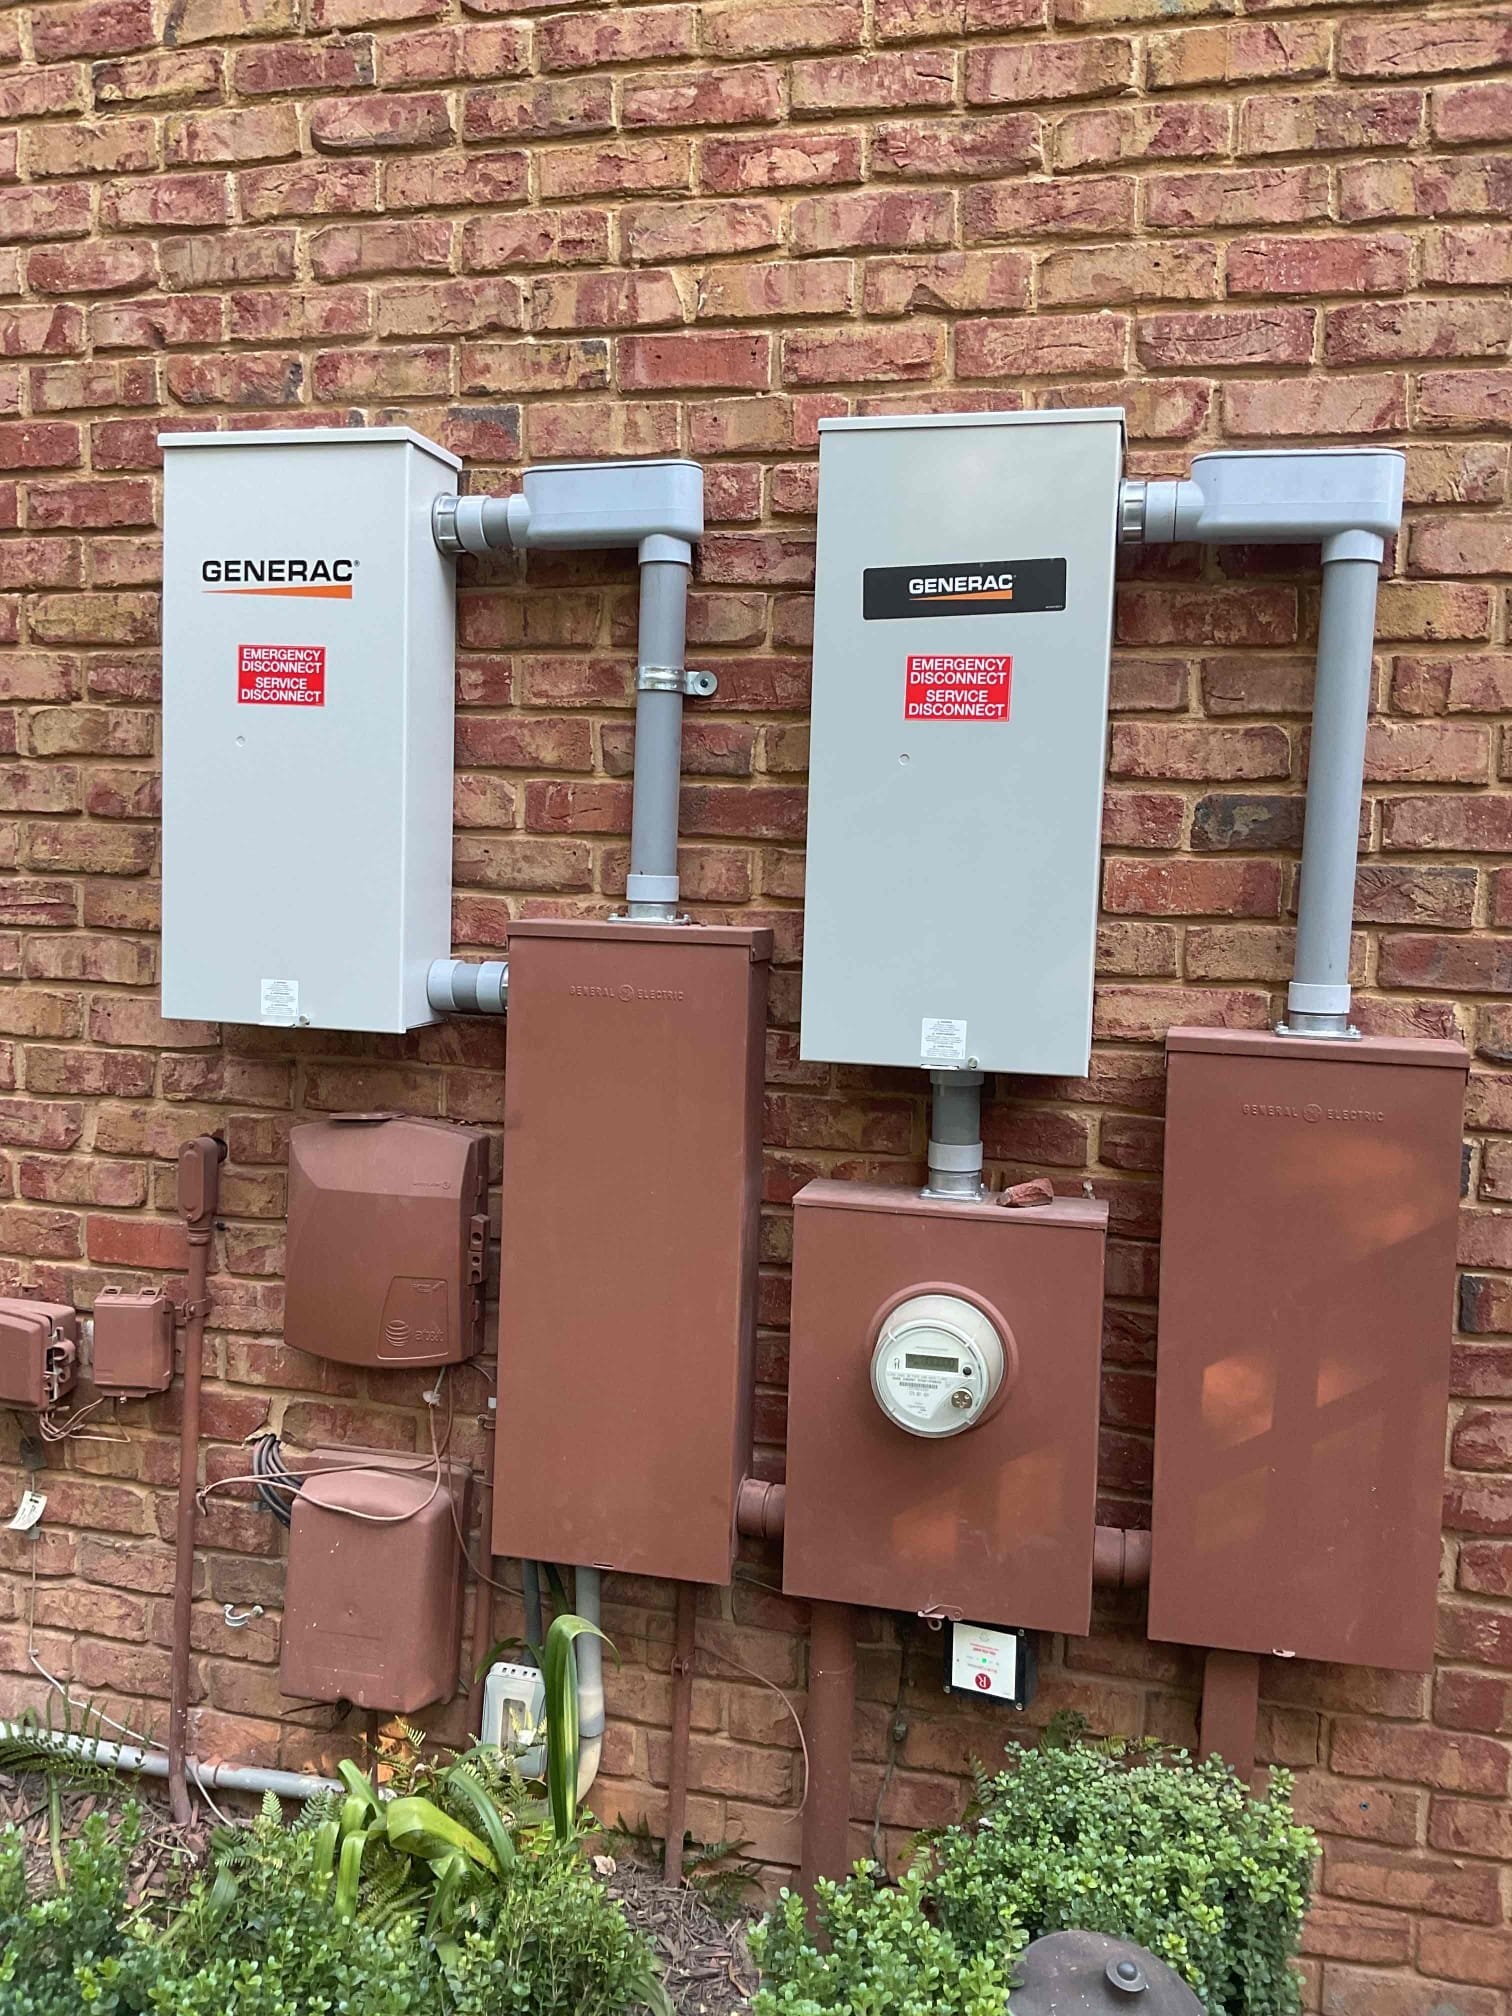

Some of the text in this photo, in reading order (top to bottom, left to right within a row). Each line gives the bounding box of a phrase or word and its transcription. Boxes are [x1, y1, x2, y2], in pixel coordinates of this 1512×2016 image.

[202, 559, 353, 582] GENERAC
[908, 574, 1013, 594] GENERAC
[243, 649, 320, 662] EMERGENCY
[242, 661, 322, 674] DISCONNECT
[912, 658, 1006, 671] EMERGENCY
[255, 677, 307, 690] SERVICE
[910, 672, 1006, 685] DISCONNECT
[241, 689, 321, 703] DISCONNECT
[925, 690, 988, 702] SERVICE
[908, 703, 1005, 717] DISCONNECT
[569, 985, 684, 1001] GENERAL ELECTRIC
[1242, 1104, 1384, 1122] GENERAL ELECTRIC
